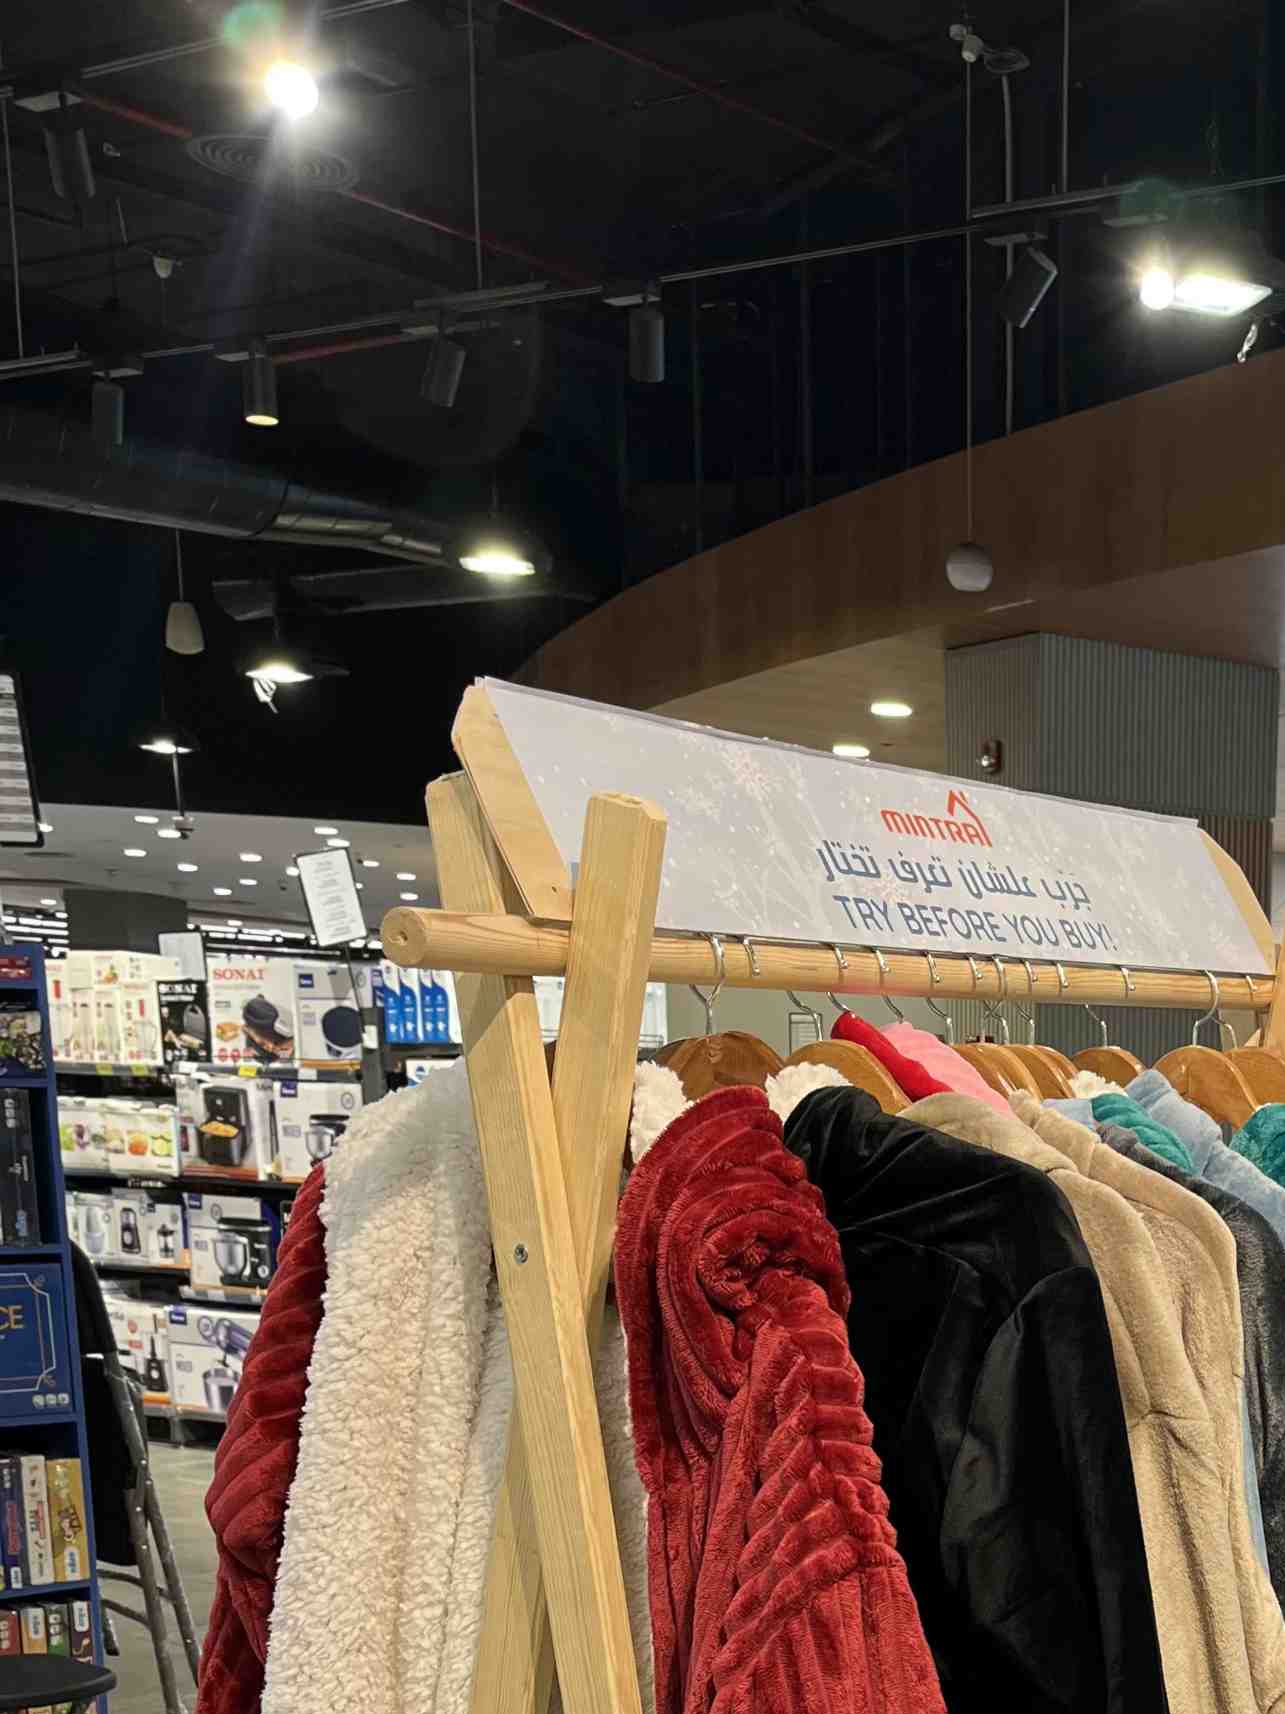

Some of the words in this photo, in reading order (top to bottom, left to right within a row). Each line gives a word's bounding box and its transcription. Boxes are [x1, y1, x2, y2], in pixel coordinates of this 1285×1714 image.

[880, 798, 992, 847] MINTRA
[815, 839, 881, 881] تختار
[887, 850, 952, 893] تعرف
[958, 859, 1037, 900] علشان
[833, 894, 895, 932] TRY
[897, 902, 1008, 943] BEFORE
[1001, 911, 1060, 948] YOU
[1057, 919, 1119, 951] BUY!
[211, 968, 265, 981] SONAI
